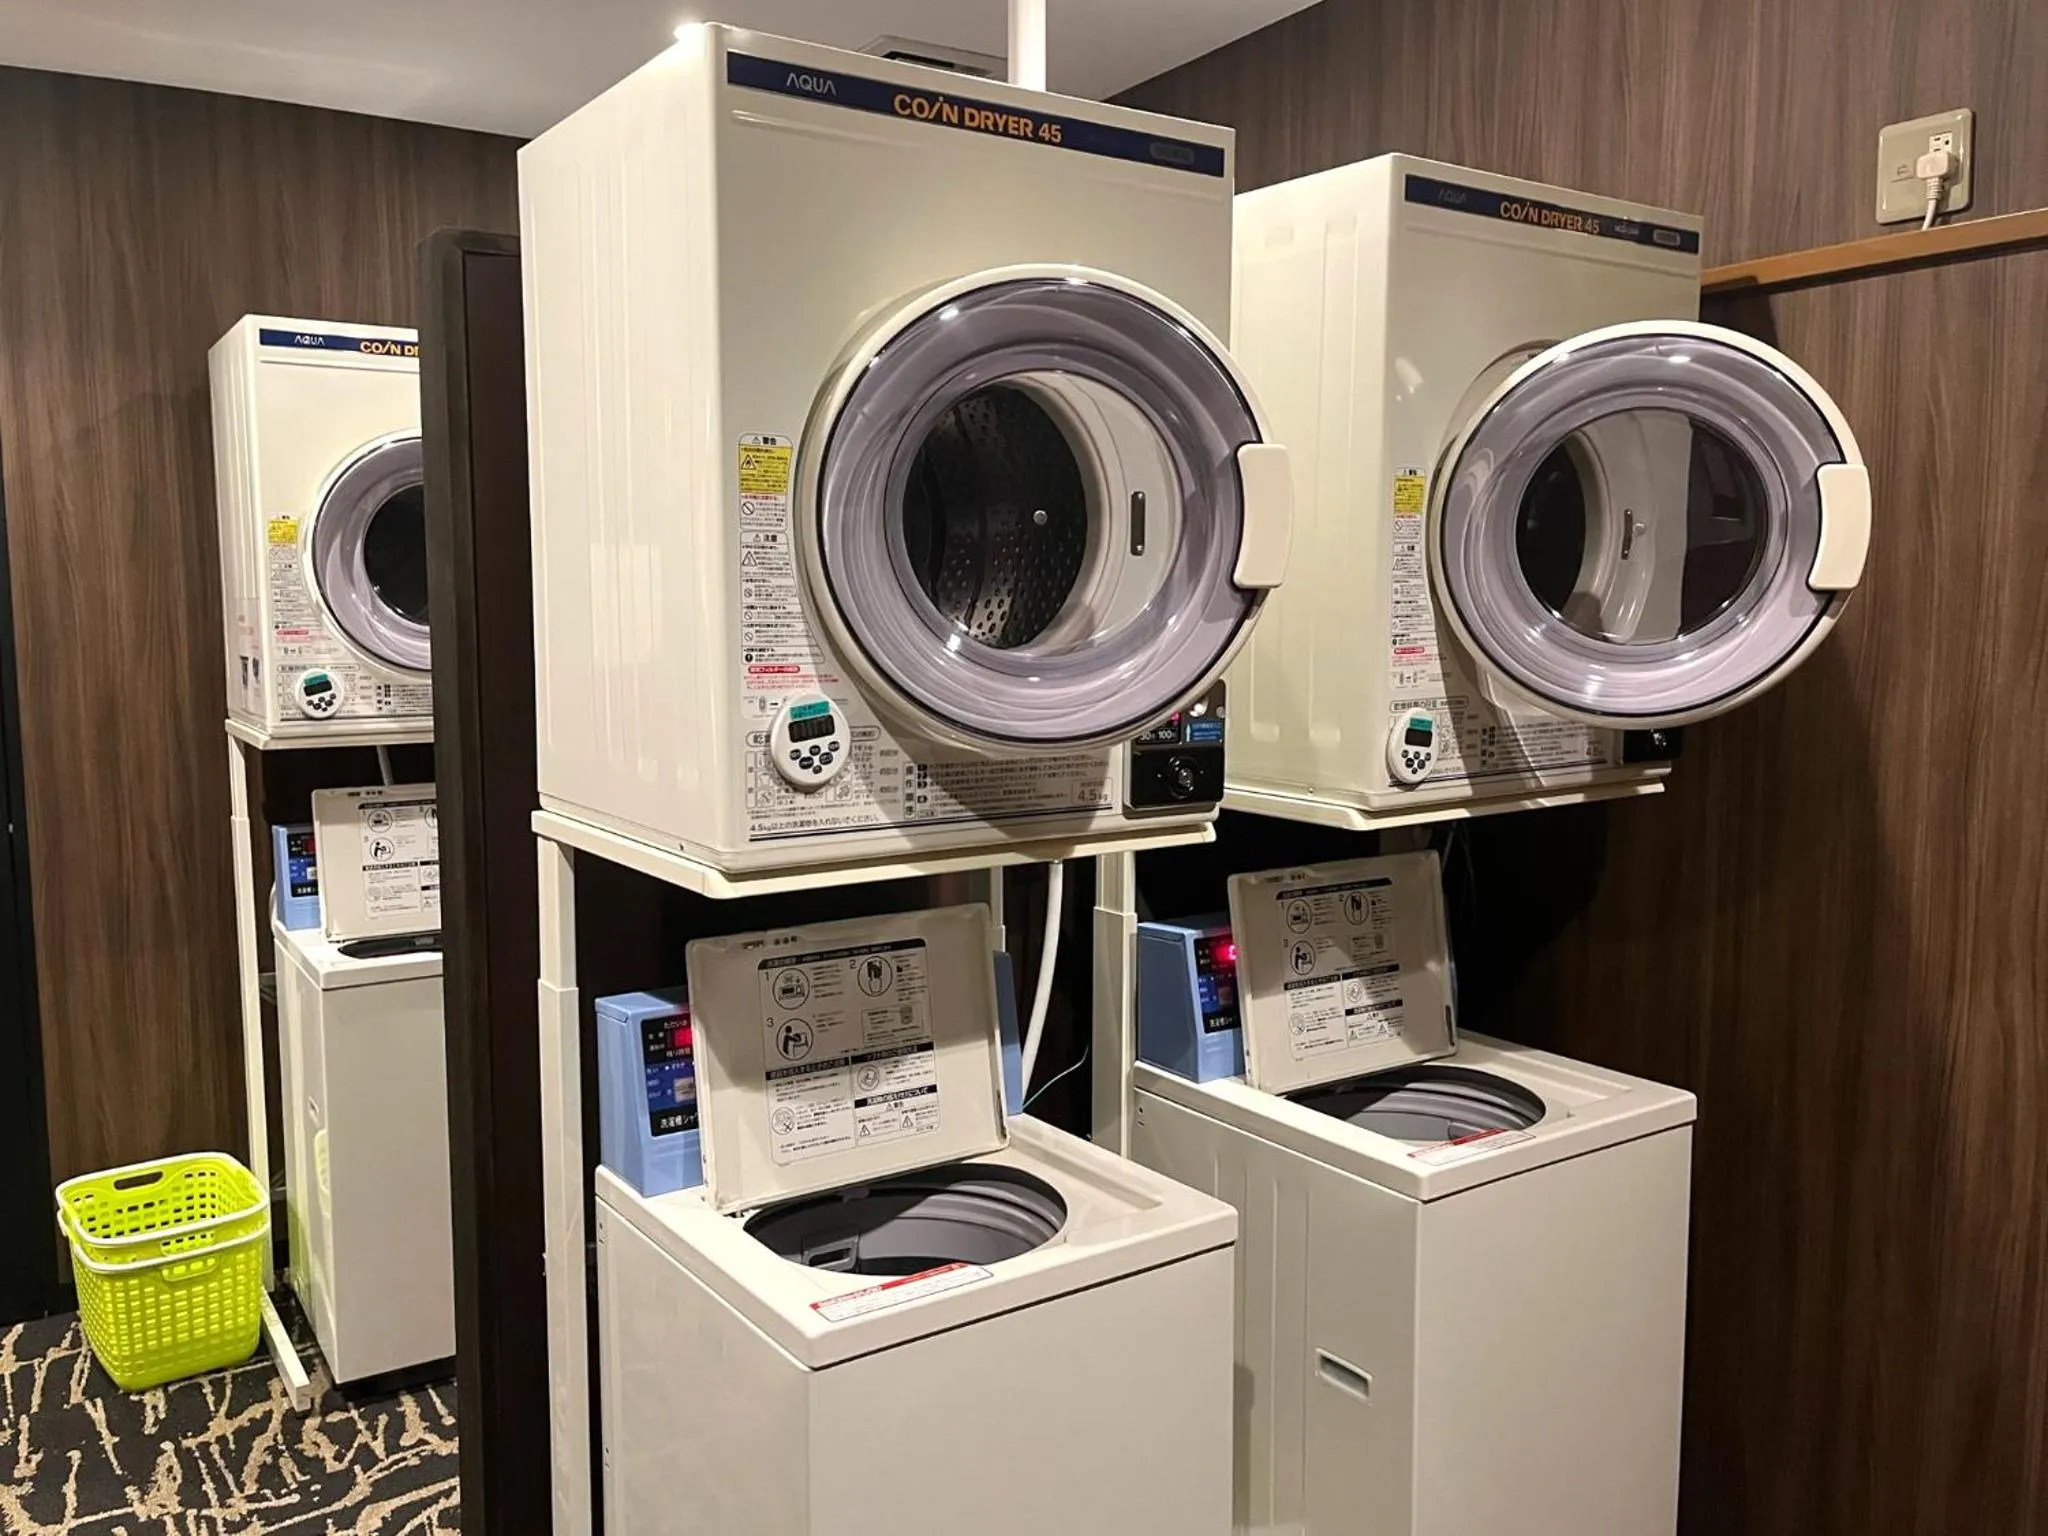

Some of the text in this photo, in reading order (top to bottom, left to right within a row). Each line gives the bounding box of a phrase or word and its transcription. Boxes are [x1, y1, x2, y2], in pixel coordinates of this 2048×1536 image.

[786, 72, 837, 96] AQUA
[964, 106, 1033, 137] DRYER
[1039, 121, 1062, 143] 45
[1541, 212, 1582, 230] DRYER
[1583, 218, 1600, 234] 45
[294, 334, 325, 346] AQUA
